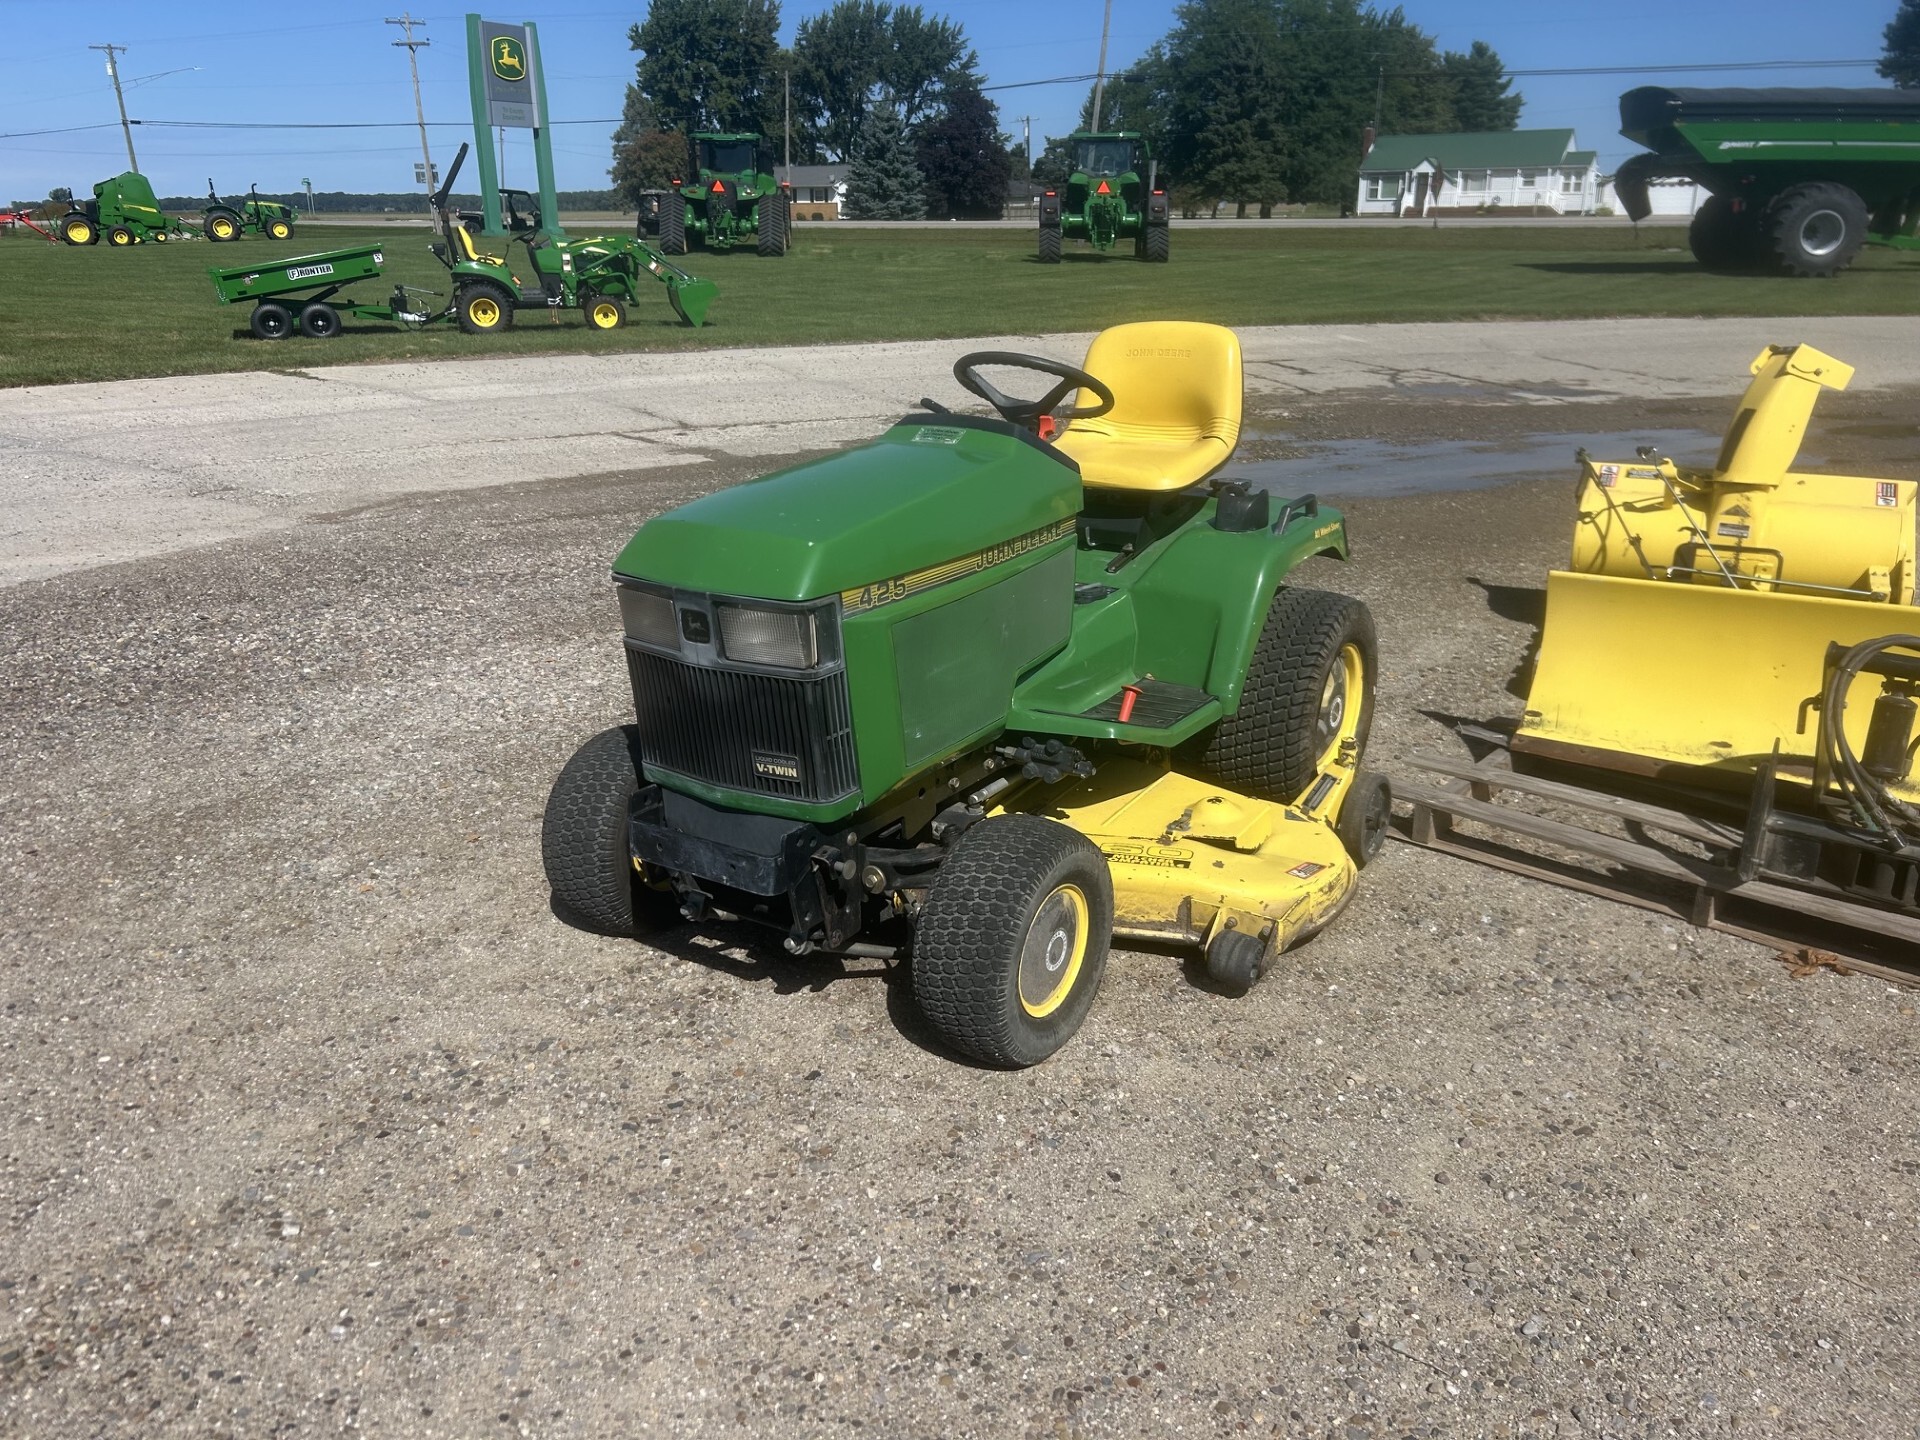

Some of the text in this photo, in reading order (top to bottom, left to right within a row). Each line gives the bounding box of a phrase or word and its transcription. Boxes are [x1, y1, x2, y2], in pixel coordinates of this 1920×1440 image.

[288, 265, 332, 279] FRONTIER
[1126, 348, 1192, 358] JOHN DEERE
[975, 540, 1016, 571] JOHN
[859, 576, 907, 608] 425
[773, 758, 796, 766] COOLED
[756, 763, 798, 778] V-TWIN
